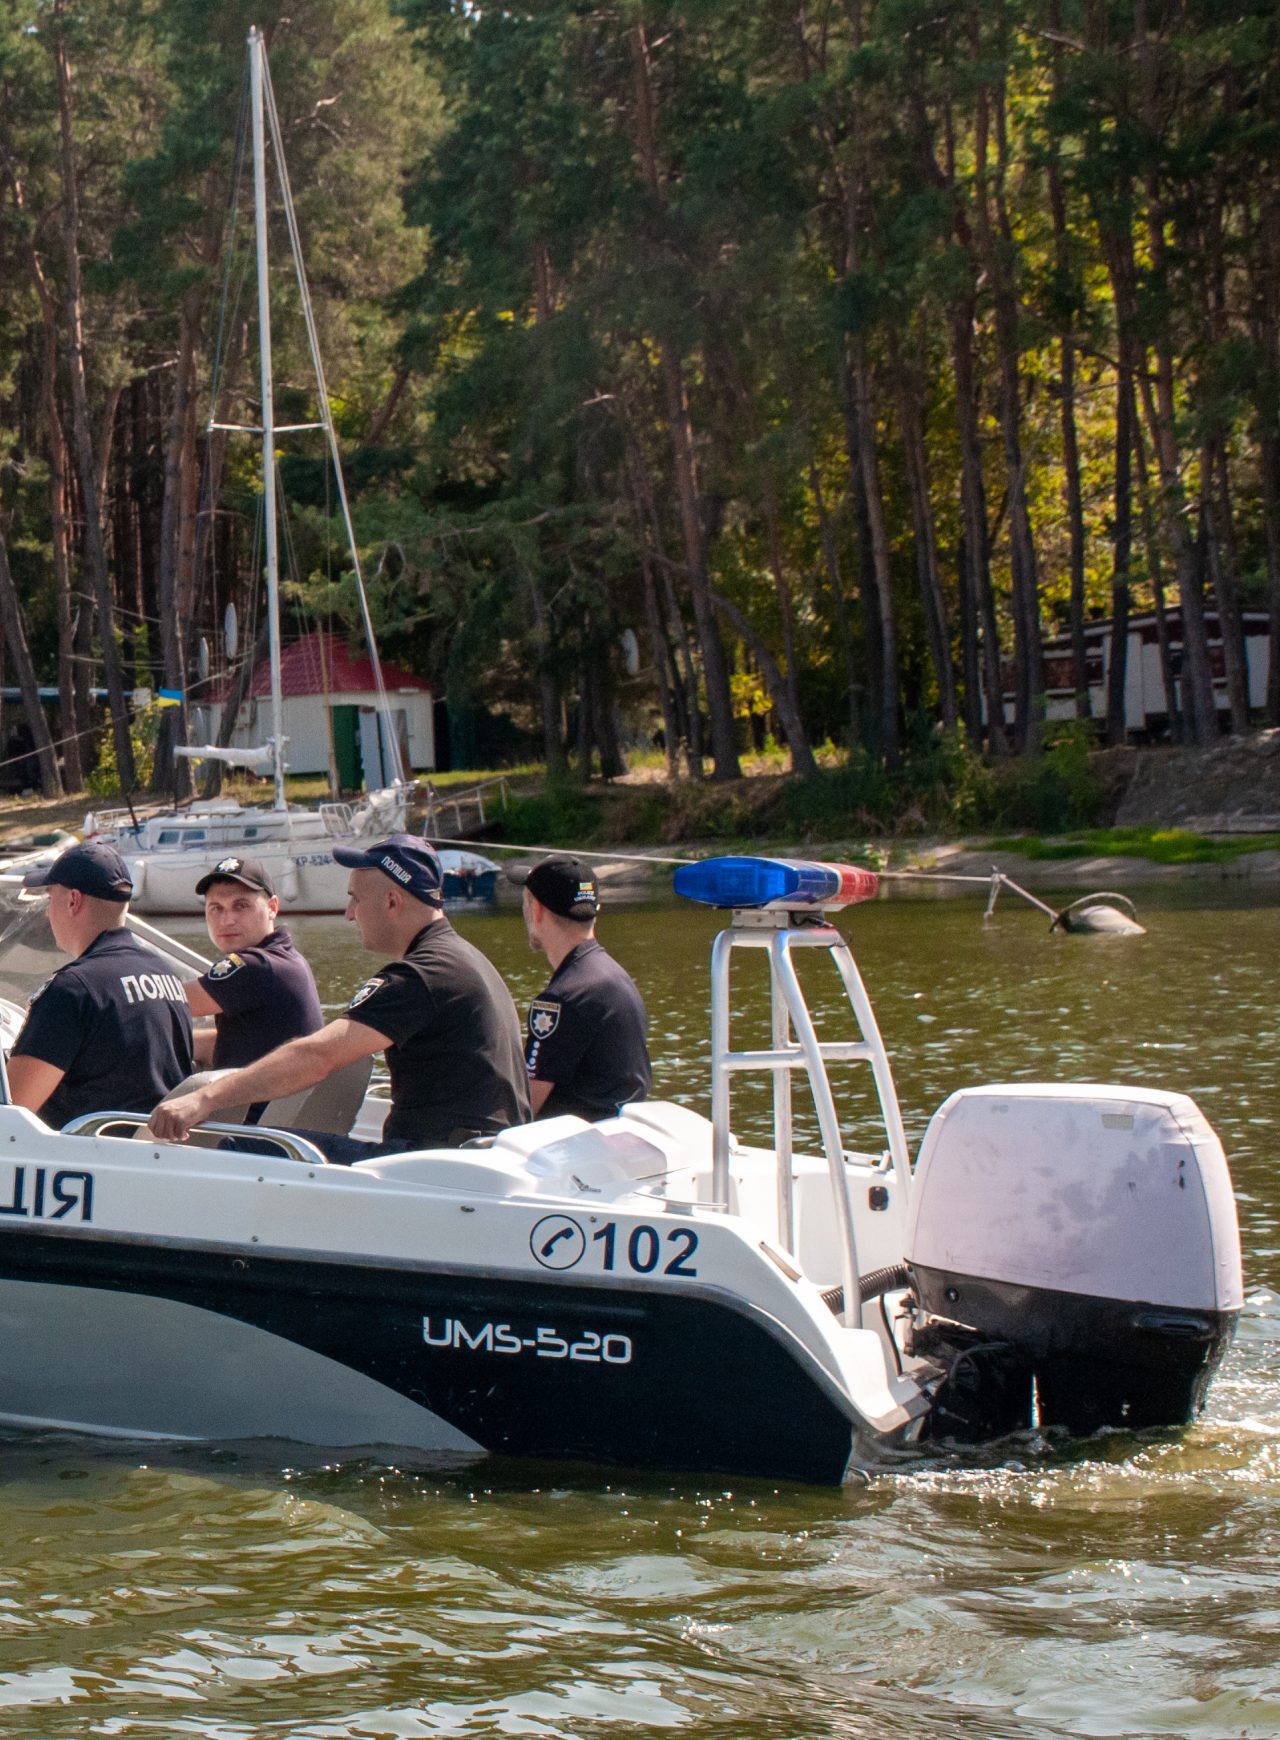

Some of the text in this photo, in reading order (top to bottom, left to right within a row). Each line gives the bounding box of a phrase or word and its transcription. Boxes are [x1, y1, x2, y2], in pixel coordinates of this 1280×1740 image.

[380, 855, 412, 884] ПОЛІЦІЯ
[593, 1222, 699, 1277] 102
[422, 1316, 633, 1364] UMS-520
